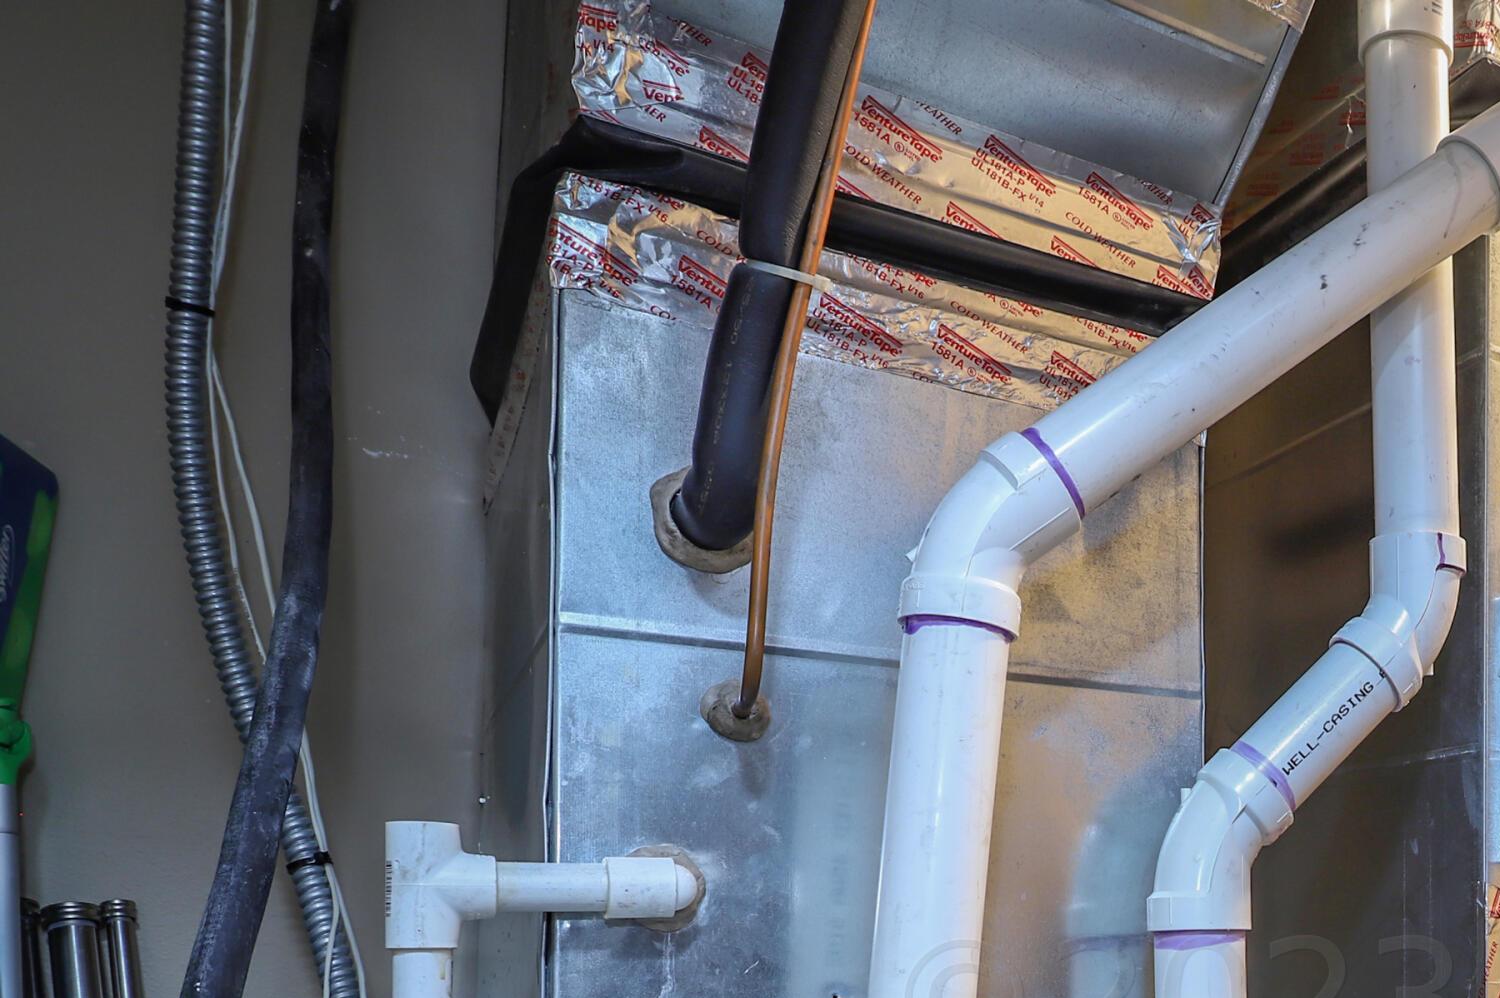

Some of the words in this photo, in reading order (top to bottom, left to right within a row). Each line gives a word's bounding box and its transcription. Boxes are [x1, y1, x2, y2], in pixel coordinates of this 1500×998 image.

[853, 111, 891, 145] 1581A
[861, 99, 942, 163] VentureTape
[872, 163, 922, 205] WEATHER
[983, 137, 1056, 197] VentureTape
[1078, 186, 1110, 216] 1581A
[1085, 175, 1153, 231] VentureTape
[1065, 211, 1093, 238] COLD
[1093, 233, 1136, 268] WEATHER
[819, 297, 903, 357] VentureTape
[980, 318, 1029, 355] WEATHER
[931, 341, 965, 370] 1581A
[936, 327, 1011, 384] VentureTape
[1281, 681, 1374, 776] WELL-CASING
